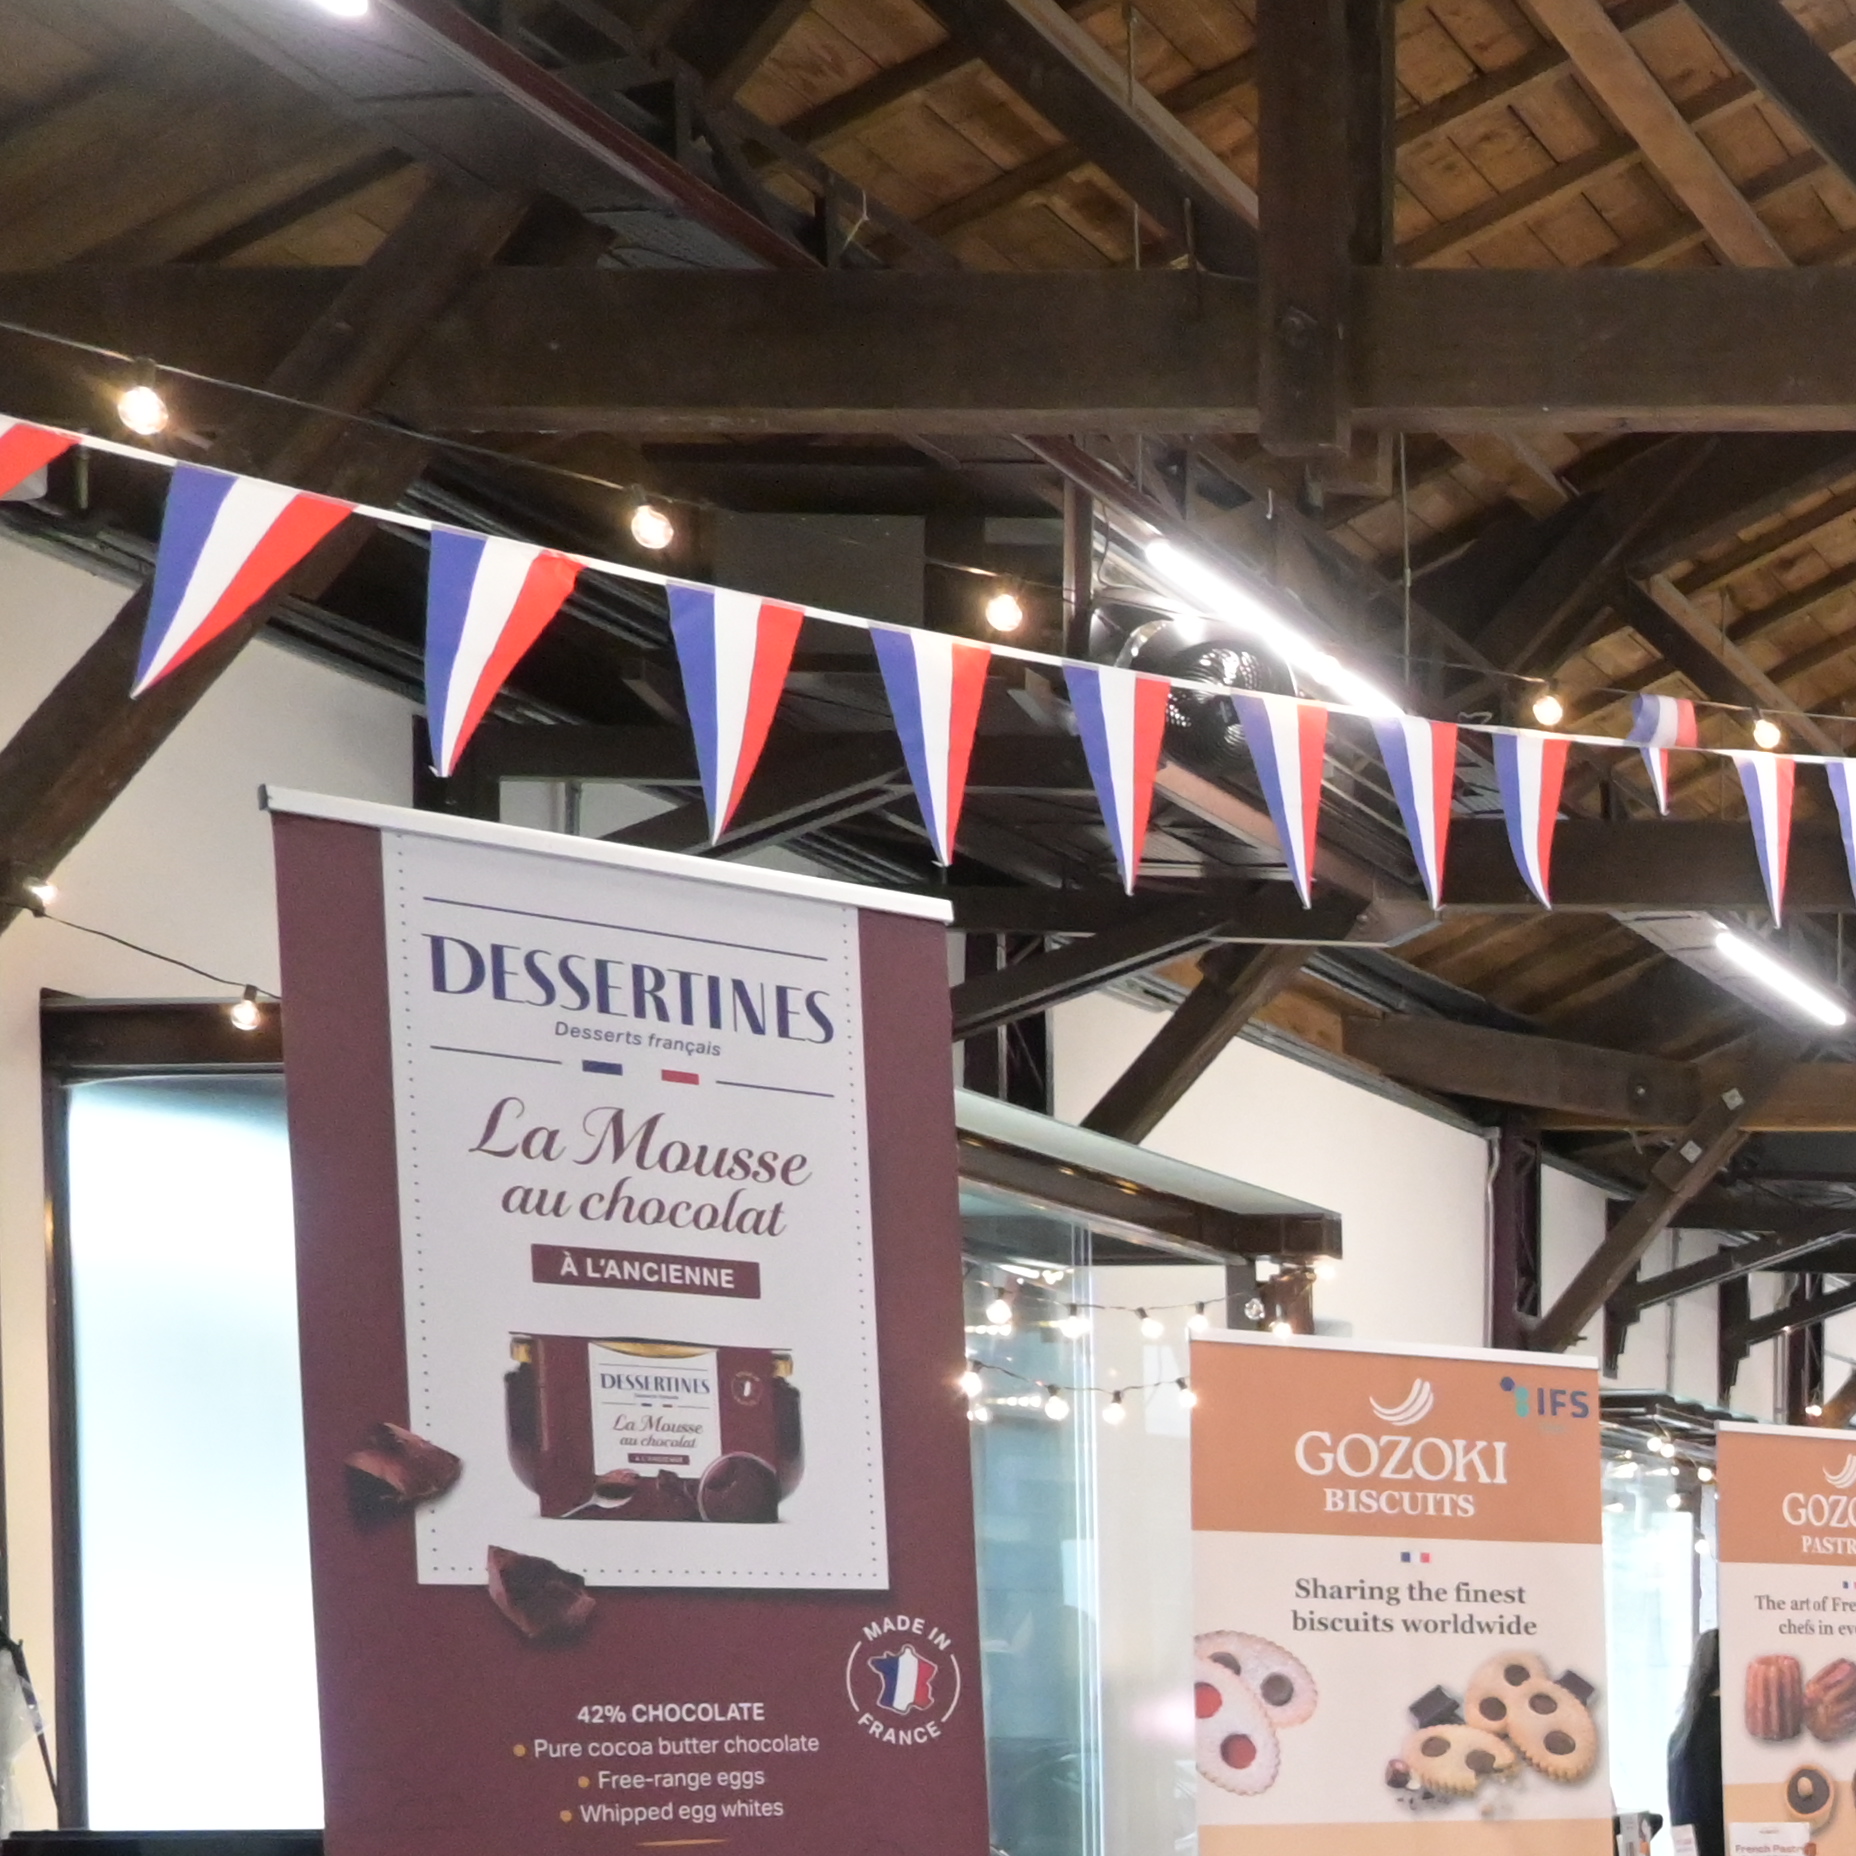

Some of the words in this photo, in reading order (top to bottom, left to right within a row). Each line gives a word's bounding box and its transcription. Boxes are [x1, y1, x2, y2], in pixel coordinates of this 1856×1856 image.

[422, 932, 835, 1044] DESSERTINES
[554, 1021, 643, 1049] Desserts
[648, 1032, 721, 1058] français
[469, 1097, 564, 1162] La
[573, 1106, 813, 1186] Mousse
[501, 1184, 572, 1219] au
[579, 1176, 787, 1237] chocolat
[560, 1251, 580, 1277] À
[586, 1257, 735, 1289] L'ANCIENNE
[600, 1373, 710, 1394] DESSERTINES
[1537, 1386, 1590, 1419] IFS
[613, 1414, 635, 1431] La
[639, 1415, 703, 1434] Mousse
[641, 1435, 697, 1448] chocolat
[1294, 1430, 1508, 1484] GOZOKI
[1324, 1488, 1475, 1517] BISCUITS
[1294, 1578, 1400, 1606] Sharing
[1406, 1582, 1448, 1602] the
[1454, 1582, 1526, 1604] finest
[1755, 1595, 1786, 1611] The
[1790, 1597, 1811, 1611] art
[1813, 1597, 1829, 1612] of
[862, 1614, 926, 1642] MADE
[928, 1626, 952, 1652] IN
[1291, 1611, 1395, 1634] biscuits
[1402, 1614, 1538, 1636] worldwide
[1779, 1619, 1815, 1635] chefs
[1818, 1621, 1834, 1636] in
[577, 1705, 626, 1724] 42%
[631, 1703, 765, 1723] CHOCOLATE
[857, 1712, 943, 1746] FRANCE
[534, 1739, 582, 1758] Pure
[588, 1739, 653, 1757] cocoa
[658, 1736, 719, 1756] butter
[723, 1734, 819, 1754] chocolate
[597, 1769, 712, 1793] Free-range
[717, 1770, 765, 1790] eggs
[580, 1802, 673, 1826] Whipped
[678, 1804, 716, 1824] egg
[721, 1799, 784, 1818] whites
